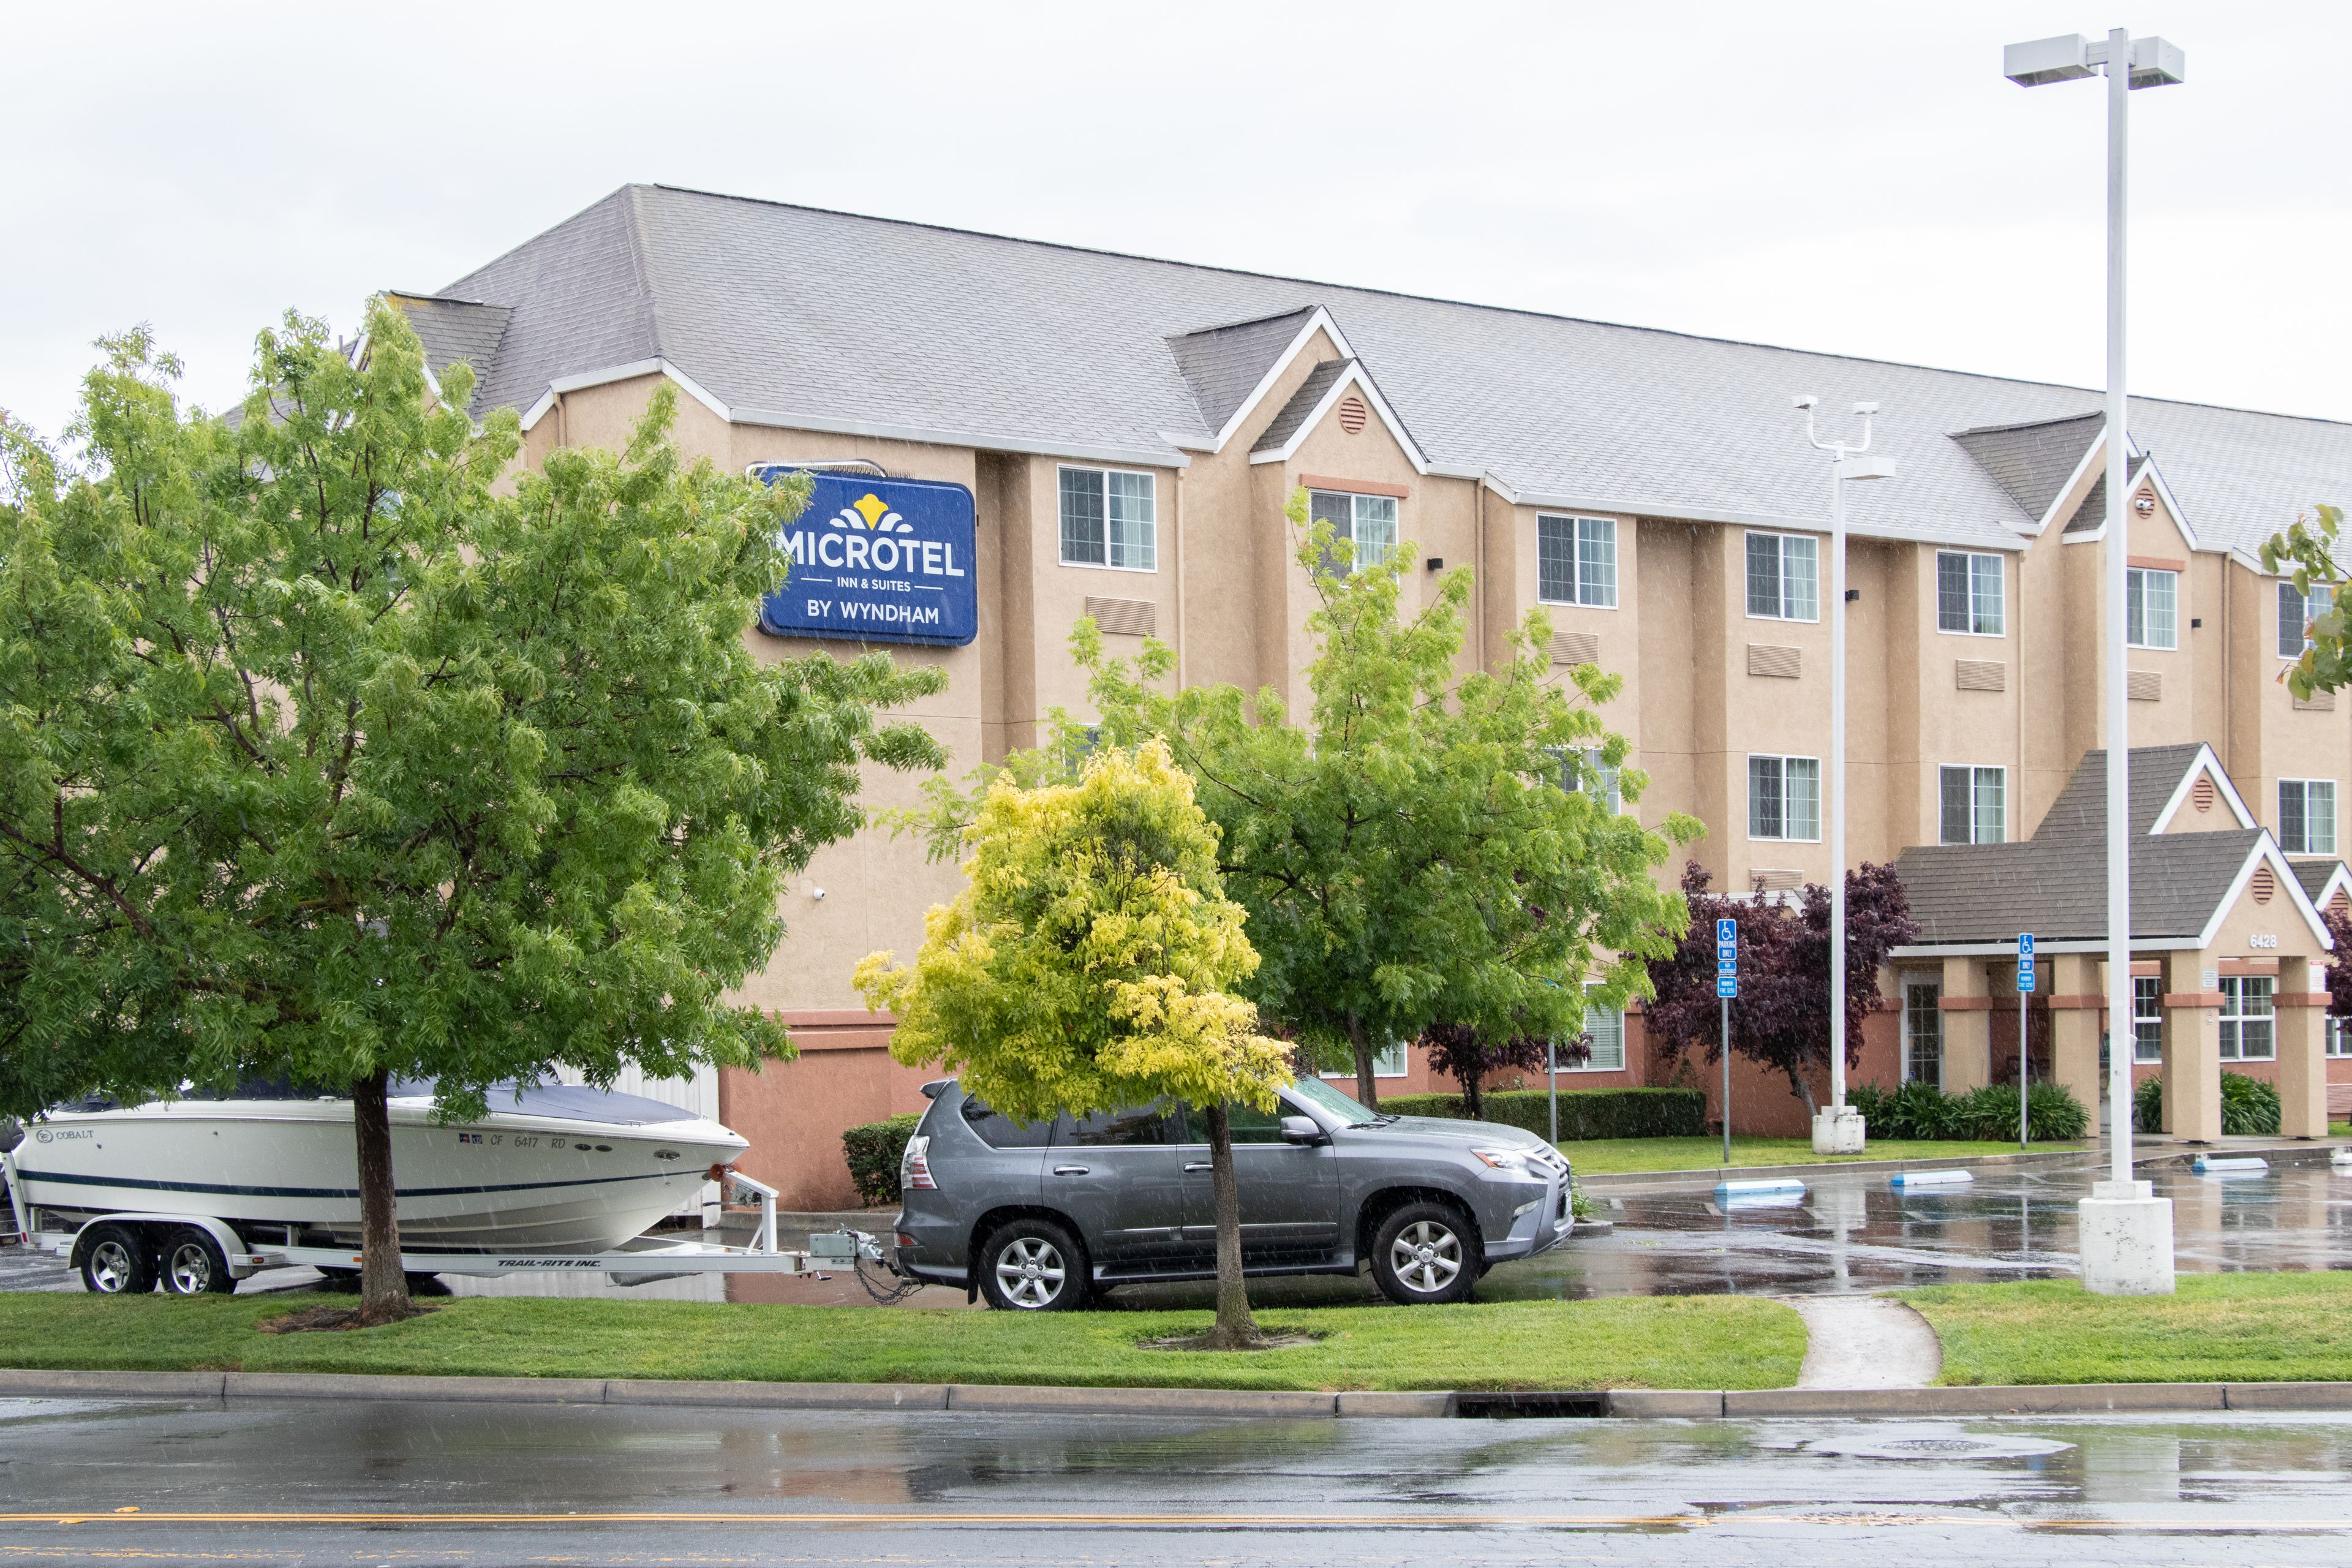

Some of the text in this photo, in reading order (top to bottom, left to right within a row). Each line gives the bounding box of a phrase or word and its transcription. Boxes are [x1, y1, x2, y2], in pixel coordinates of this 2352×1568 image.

[776, 530, 965, 577] MICROTEL
[837, 576, 911, 592] INN & SUITES
[807, 600, 939, 624] BY WYNDHAM
[2250, 934, 2277, 948] 6428
[56, 1130, 94, 1139] COBALT
[491, 1135, 566, 1148] CF 6417 RD
